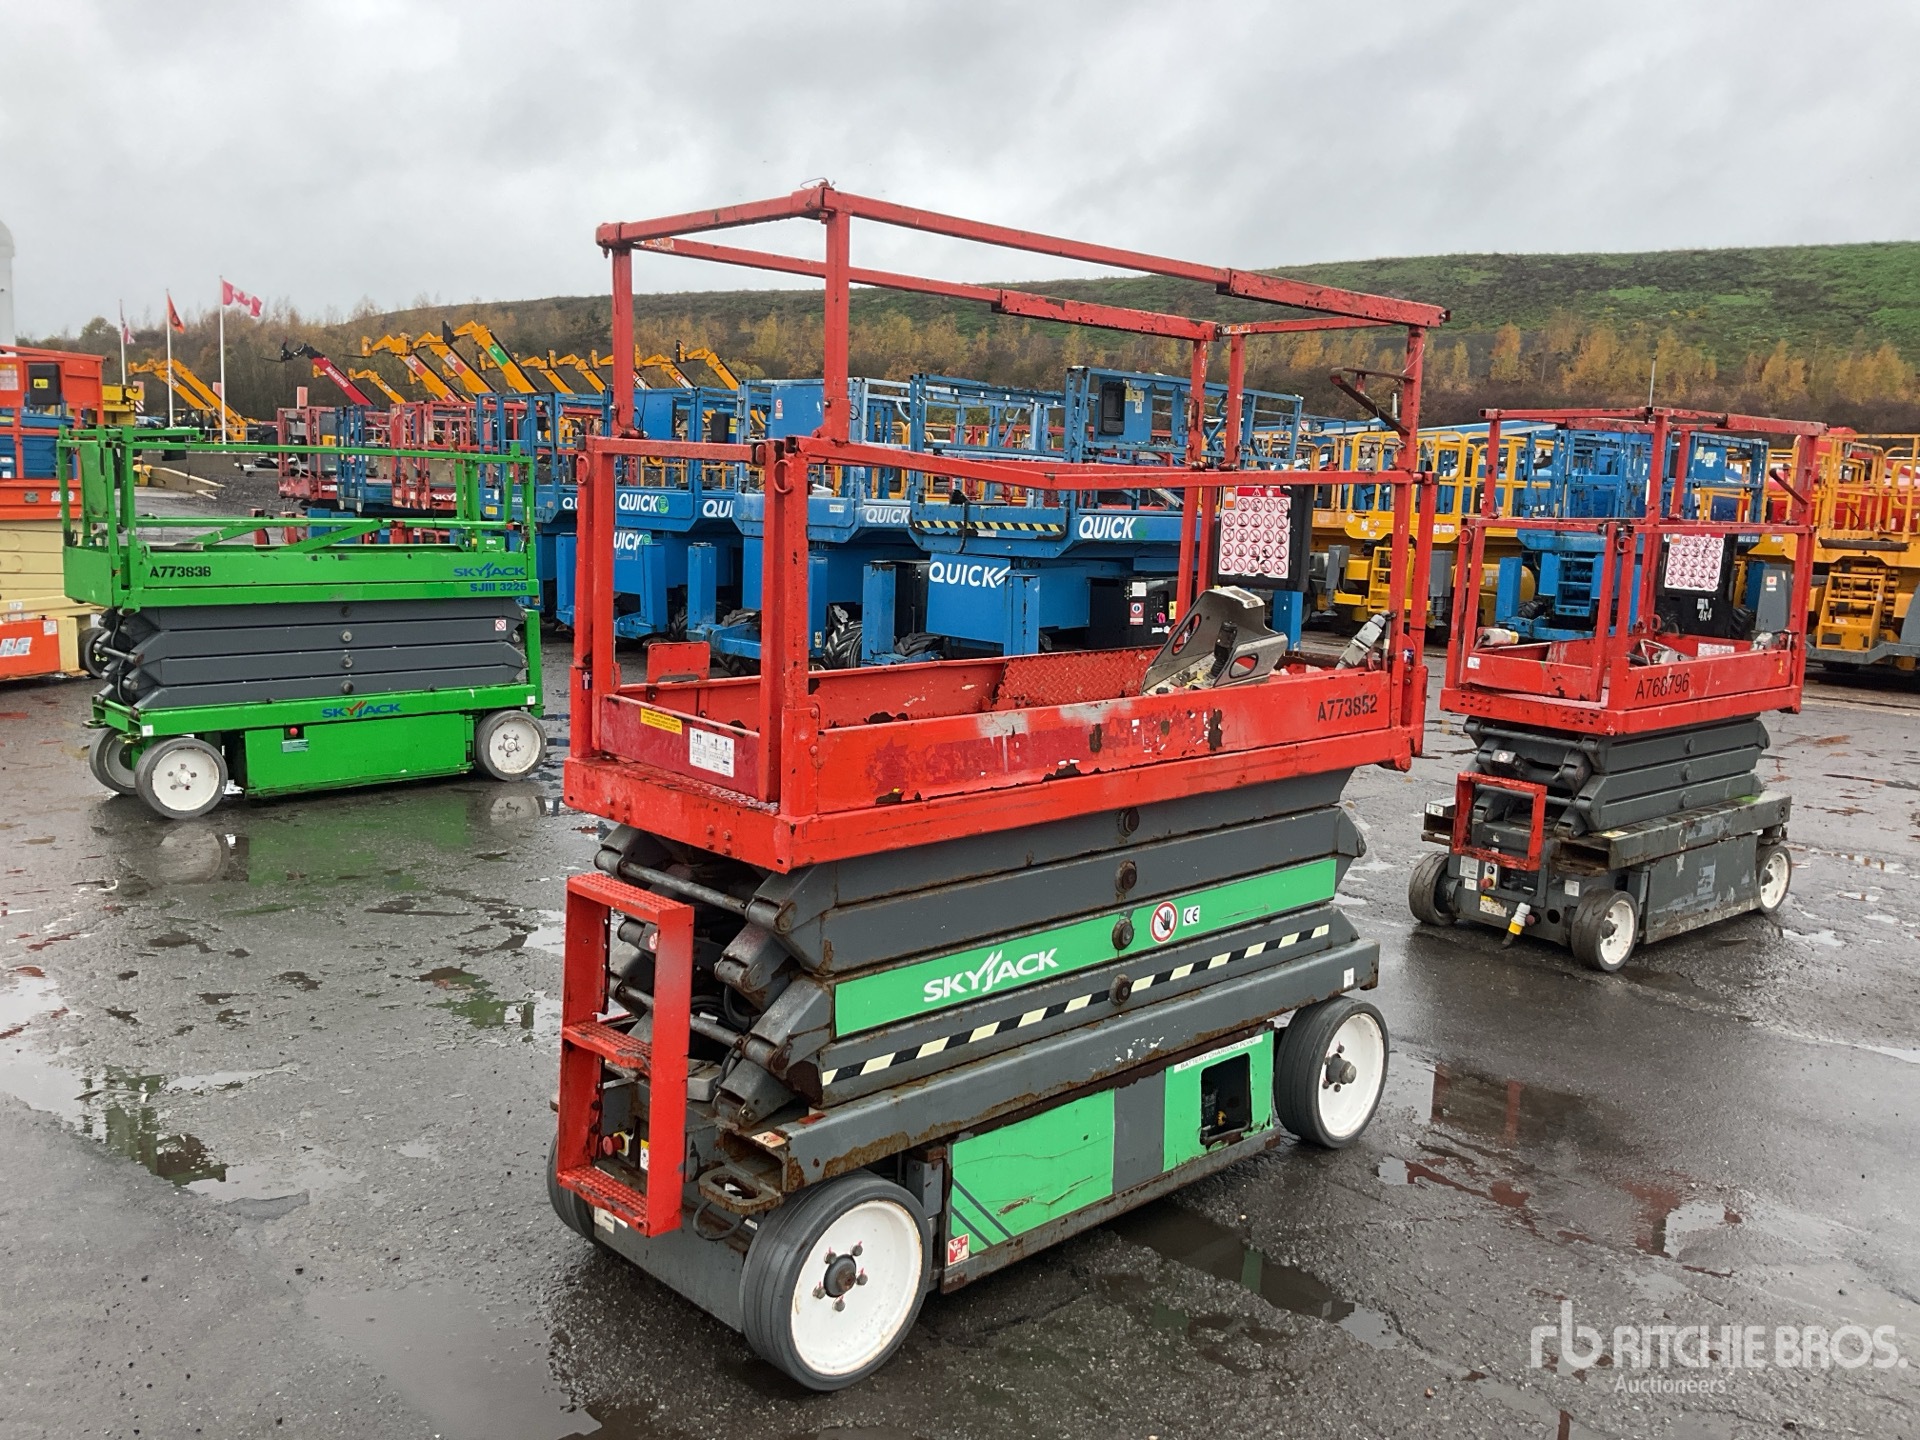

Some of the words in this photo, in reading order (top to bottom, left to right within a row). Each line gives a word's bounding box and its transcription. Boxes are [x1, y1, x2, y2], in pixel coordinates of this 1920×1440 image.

[619, 493, 658, 513] QUICK
[703, 499, 733, 518] QUI
[866, 508, 910, 524] QUICK
[1079, 516, 1136, 538] QUICK
[613, 531, 642, 550] UICK
[454, 562, 525, 578] SKYJACK
[929, 562, 996, 588] QUICK
[500, 583, 527, 591] 3226
[1635, 673, 1690, 700] A768796
[322, 701, 402, 717] SKYJACK
[1318, 694, 1377, 722] A773852
[1185, 907, 1198, 923] CE
[923, 949, 1060, 1003] SKYJACK
[1181, 1054, 1208, 1069] BATTERY
[1208, 1045, 1239, 1058] CHARGING
